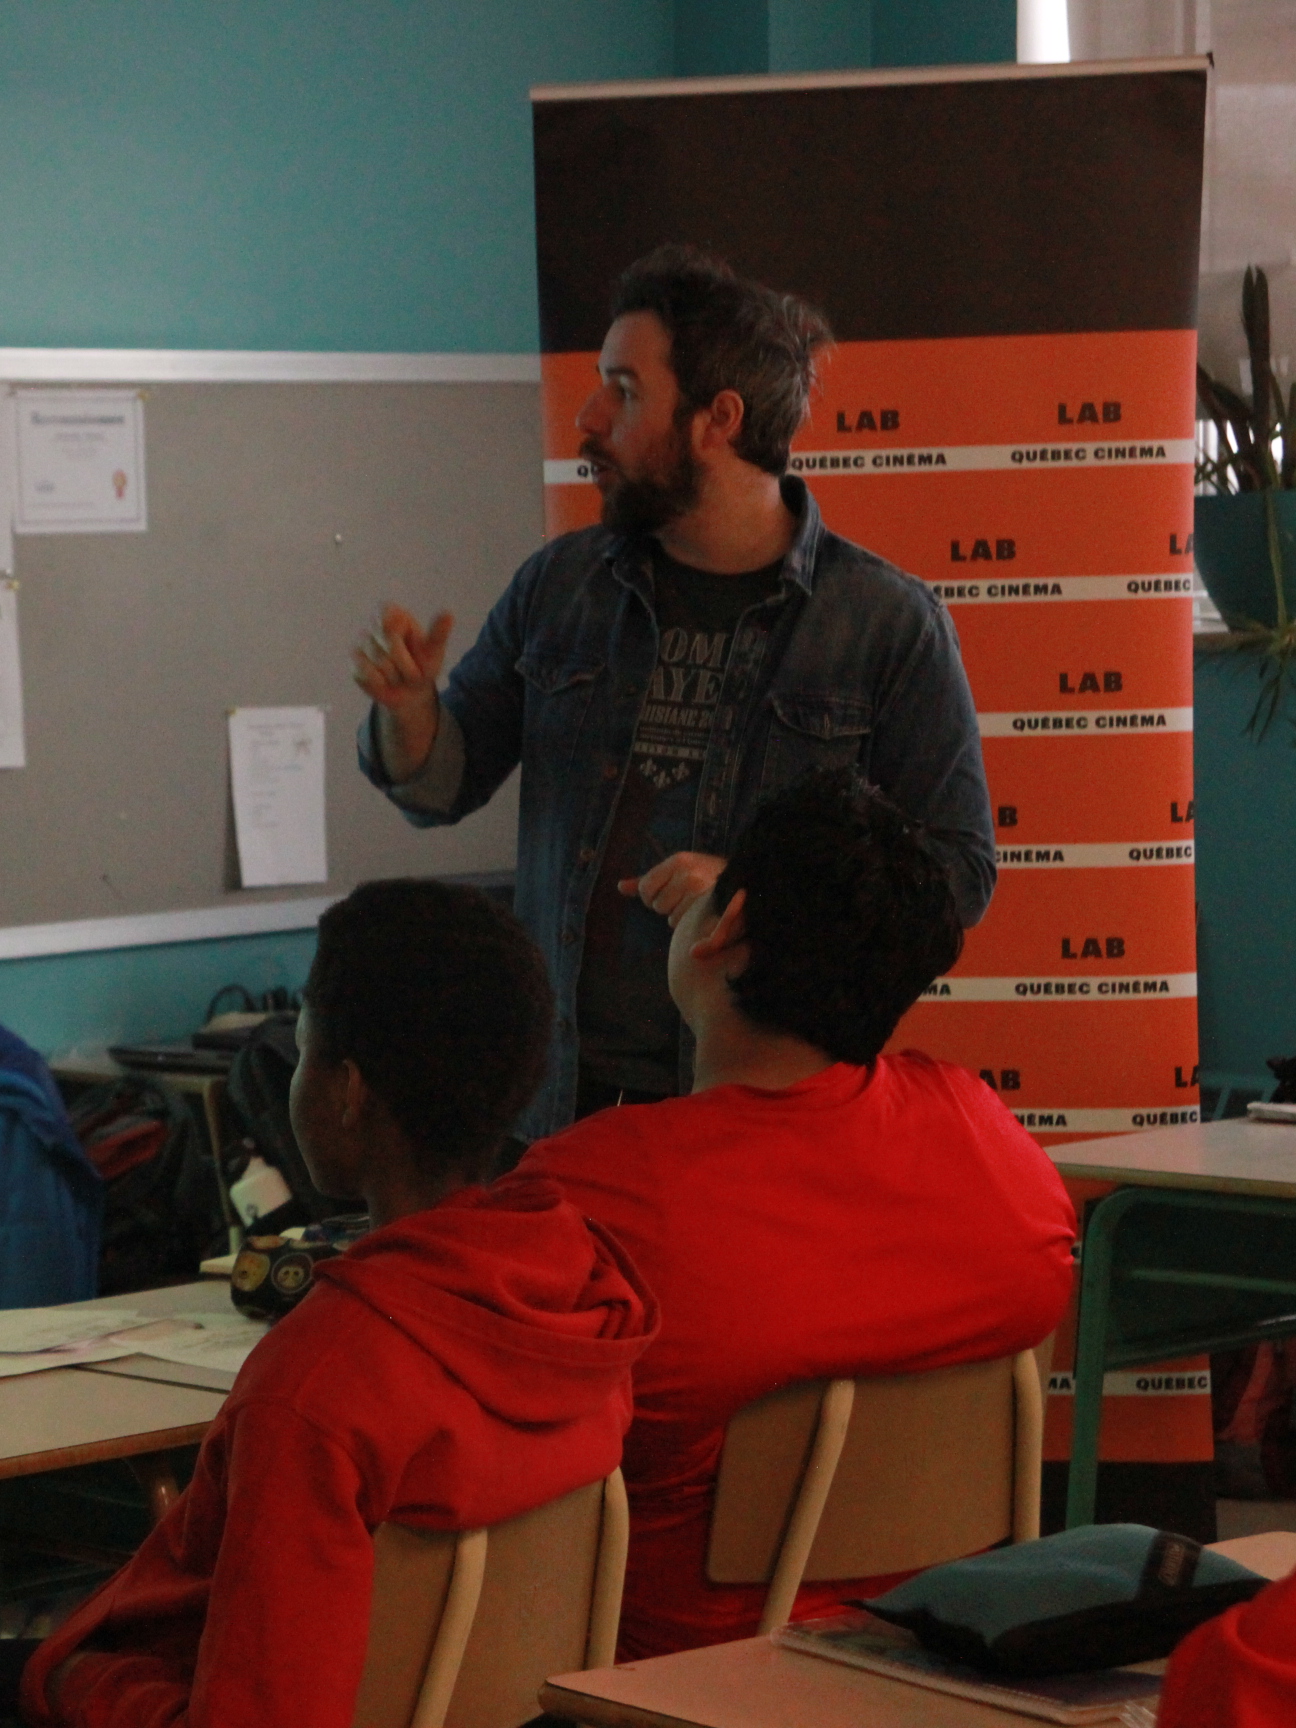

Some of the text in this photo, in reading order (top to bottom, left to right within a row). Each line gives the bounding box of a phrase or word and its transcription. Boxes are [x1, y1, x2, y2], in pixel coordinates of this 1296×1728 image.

[836, 410, 900, 433] LAB
[1057, 402, 1122, 425] LAB
[791, 452, 947, 471] QUÉBEC CINÉMA
[1010, 445, 1166, 464] QUÉBEC CINÉMA
[950, 539, 1016, 562] LAB
[933, 582, 1063, 599] ÉBEC CINÉMA
[1126, 579, 1191, 594] QUÉBEC
[1059, 671, 1123, 694] LAB
[1012, 714, 1167, 732] QUÉBEC CINÉMA
[1128, 847, 1192, 861] QUÉBEC
[1061, 937, 1126, 959] LAB
[1014, 980, 1170, 997] QUÉBEC CINÉMA
[979, 1069, 1021, 1091] AB
[1018, 1113, 1067, 1127] NÉMA
[1131, 1111, 1198, 1127] QUÉBEC
